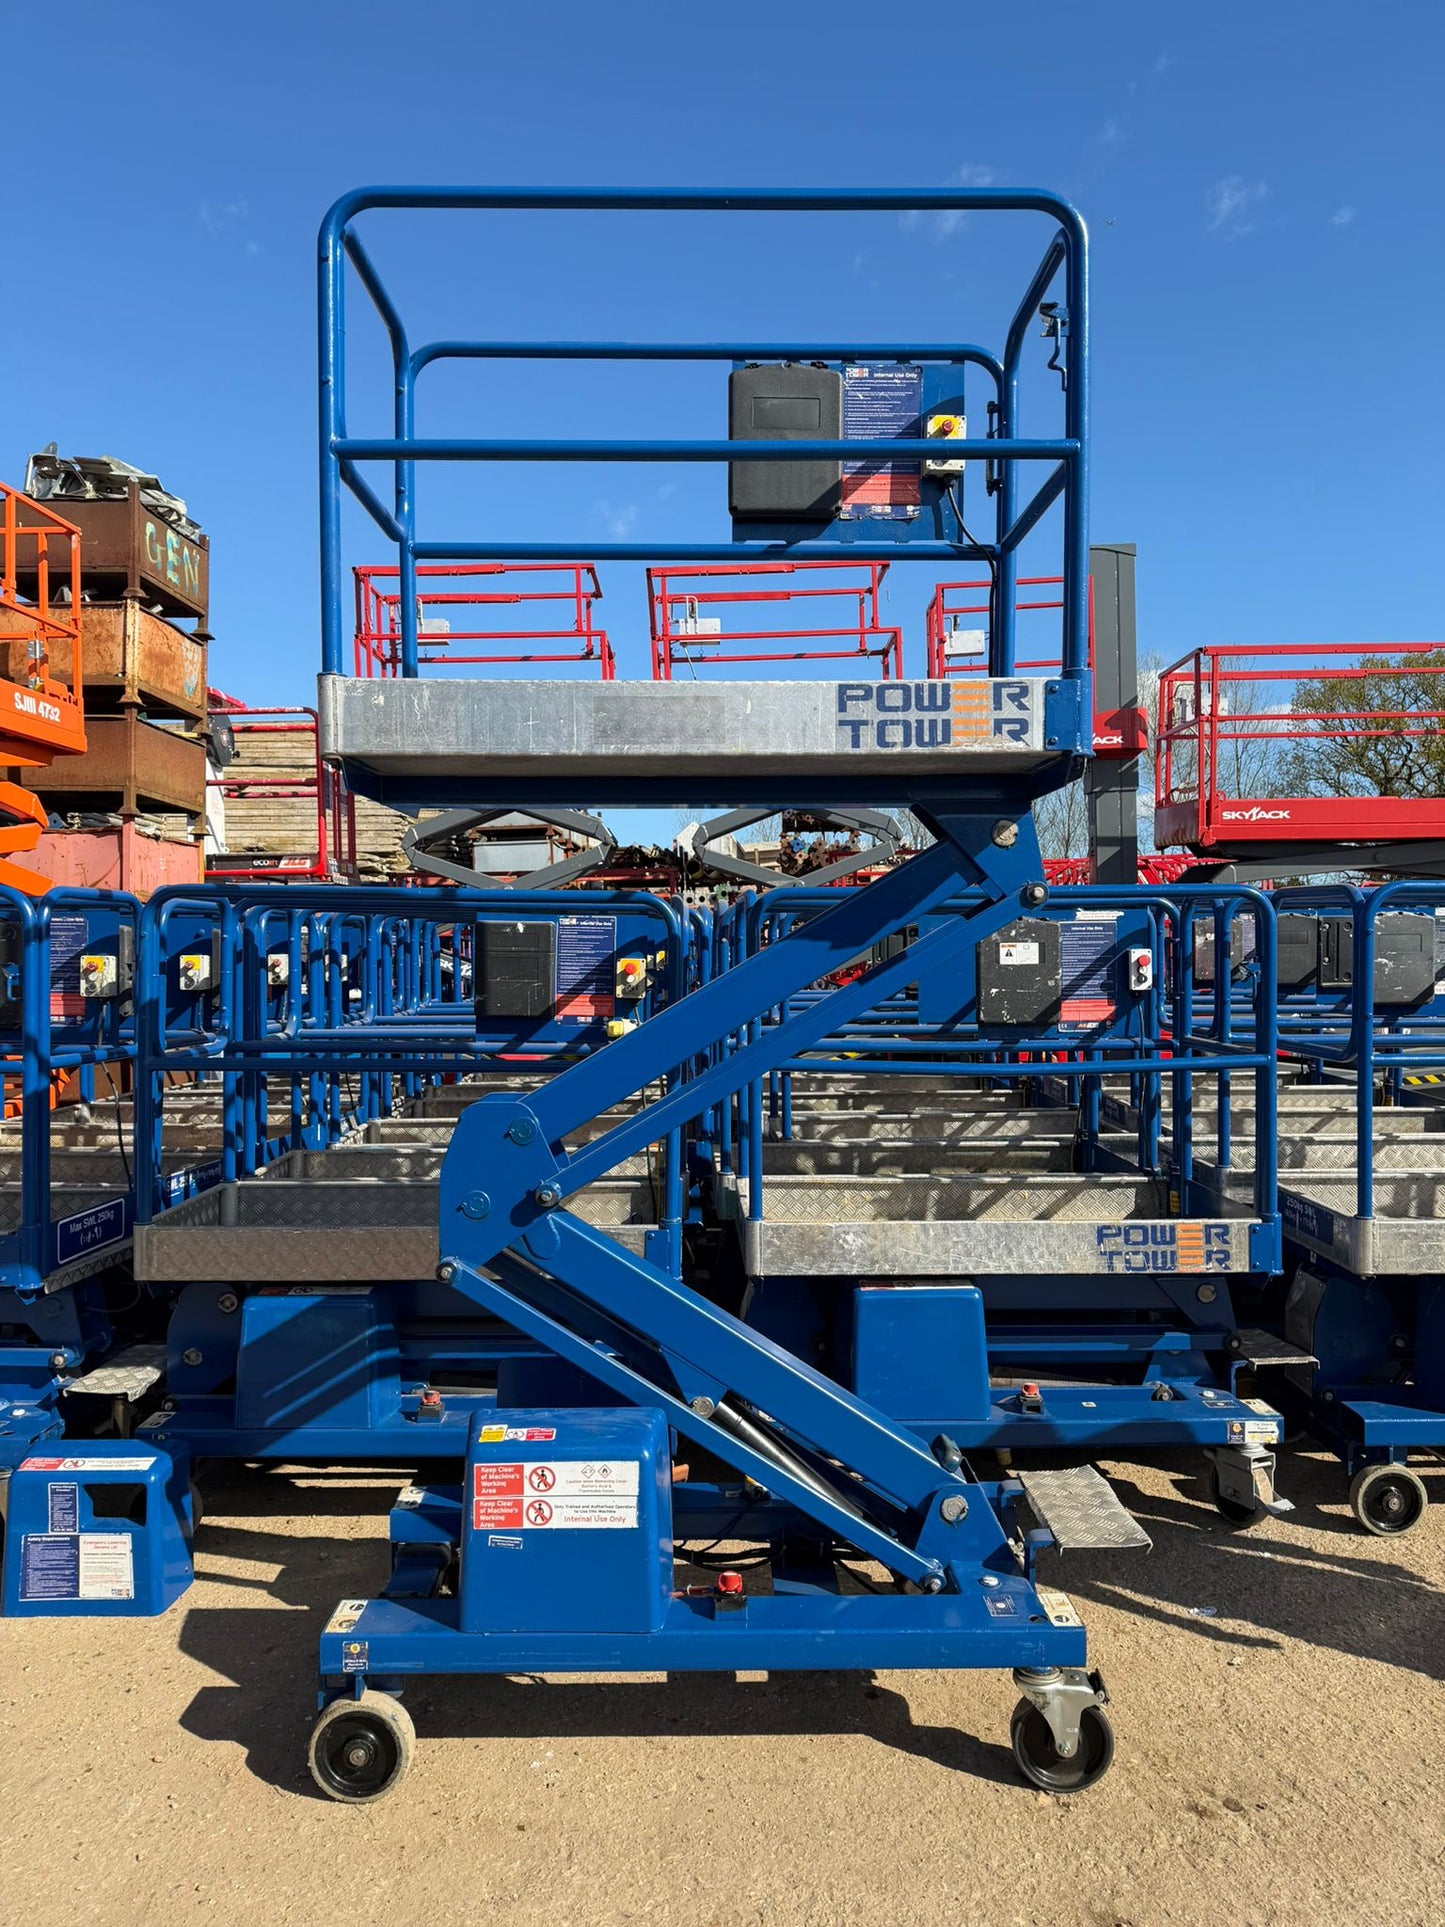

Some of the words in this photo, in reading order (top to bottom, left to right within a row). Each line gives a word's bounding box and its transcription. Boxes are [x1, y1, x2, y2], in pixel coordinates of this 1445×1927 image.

[145, 521, 200, 598] GEN
[837, 681, 1031, 713] POWER
[38, 700, 61, 723] 4732
[837, 717, 1031, 749] TOWER
[1092, 732, 1125, 745] ACK
[1221, 806, 1292, 822] SKYJACK
[83, 1215, 97, 1229] SWL
[1096, 1223, 1231, 1246] POWER
[1098, 1249, 1232, 1273] TOWER
[480, 1480, 507, 1488] Working
[479, 1500, 496, 1508] Keep
[479, 1514, 505, 1522] Working
[594, 1515, 608, 1523] Use
[609, 1515, 626, 1524] Only
